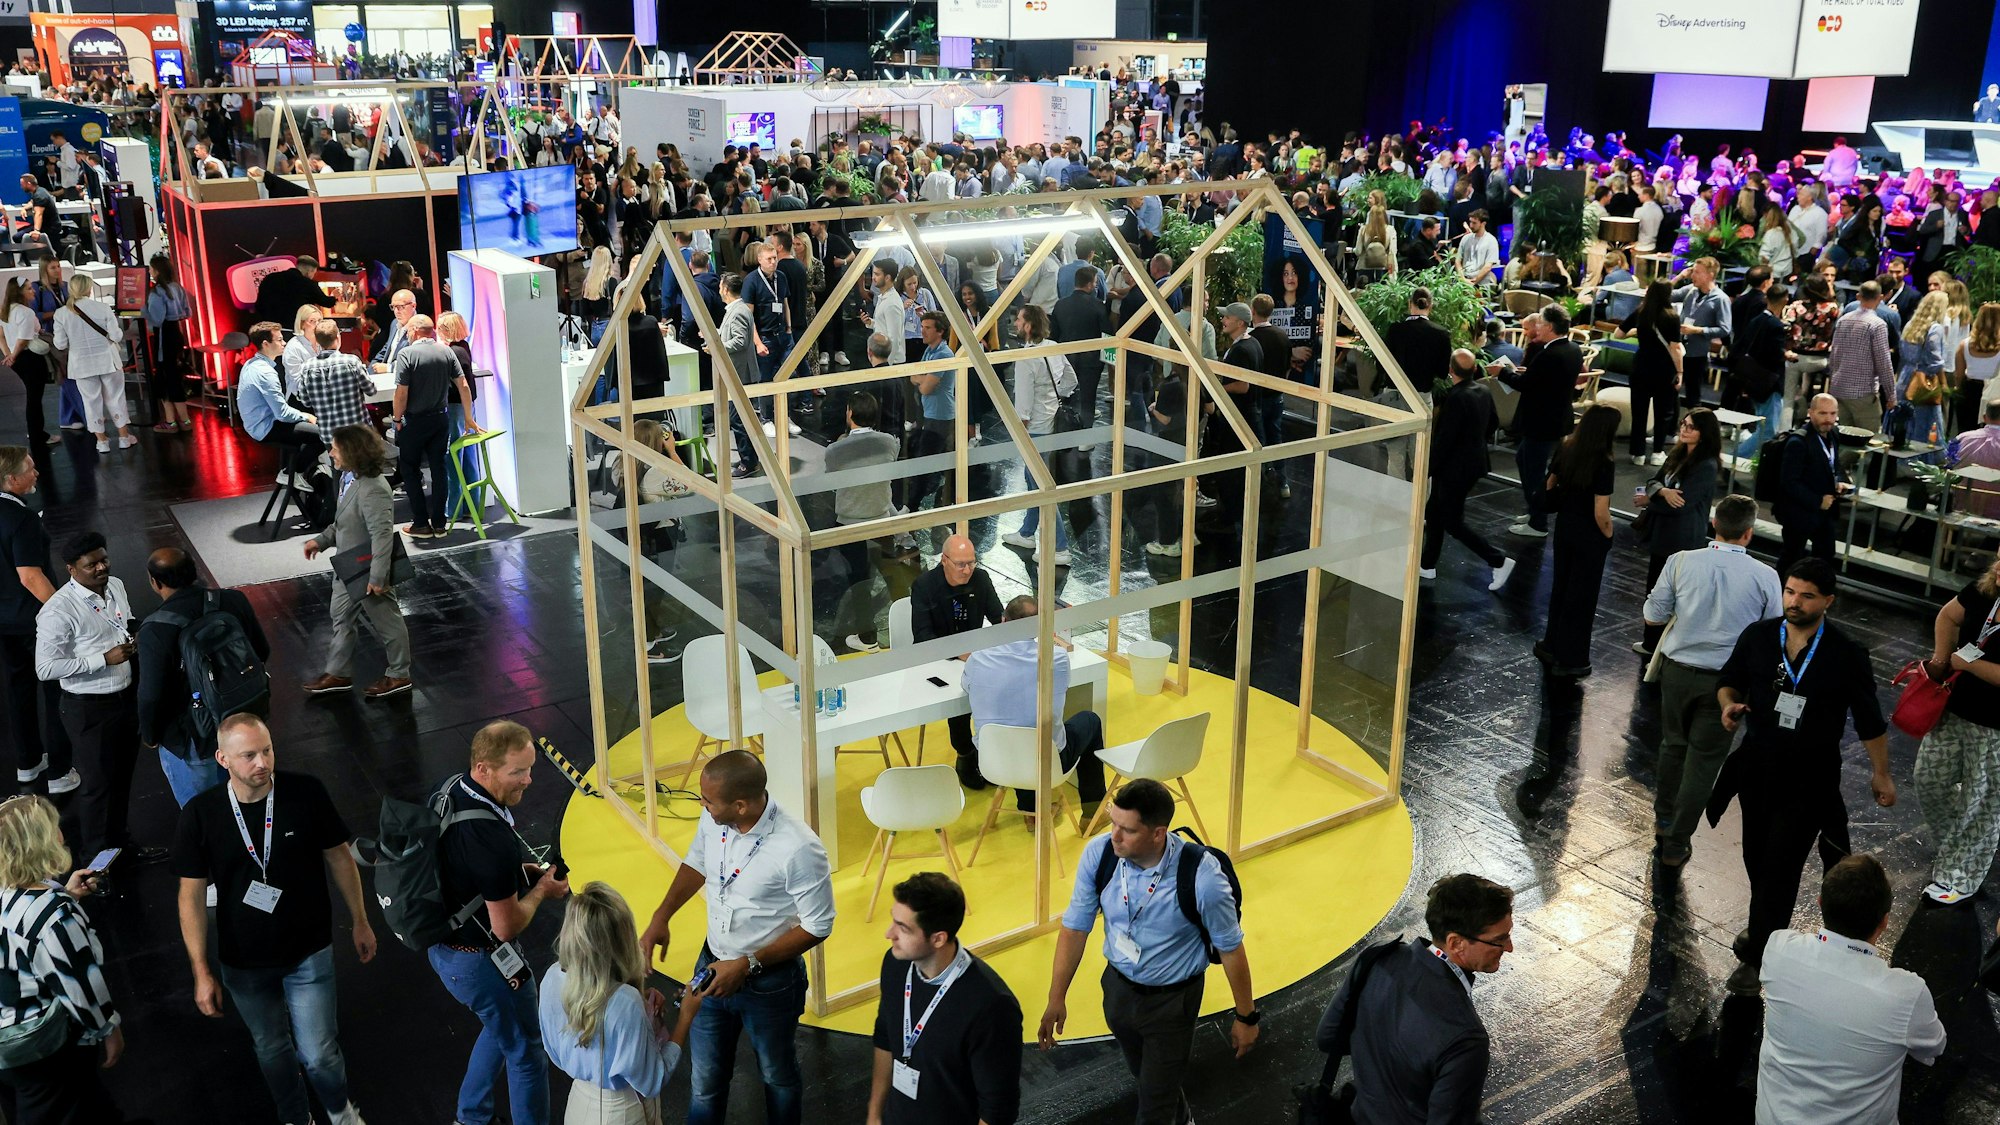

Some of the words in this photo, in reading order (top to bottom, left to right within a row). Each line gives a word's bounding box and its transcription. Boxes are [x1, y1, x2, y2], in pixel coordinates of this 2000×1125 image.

[216, 17, 228, 26] 3D
[229, 17, 246, 26] LED
[247, 17, 279, 28] Display,
[280, 17, 295, 26] 257
[1656, 13, 1692, 31] Disney
[1693, 18, 1746, 30] Advertising
[687, 108, 700, 118] SCREEN
[688, 118, 700, 130] FORCE
